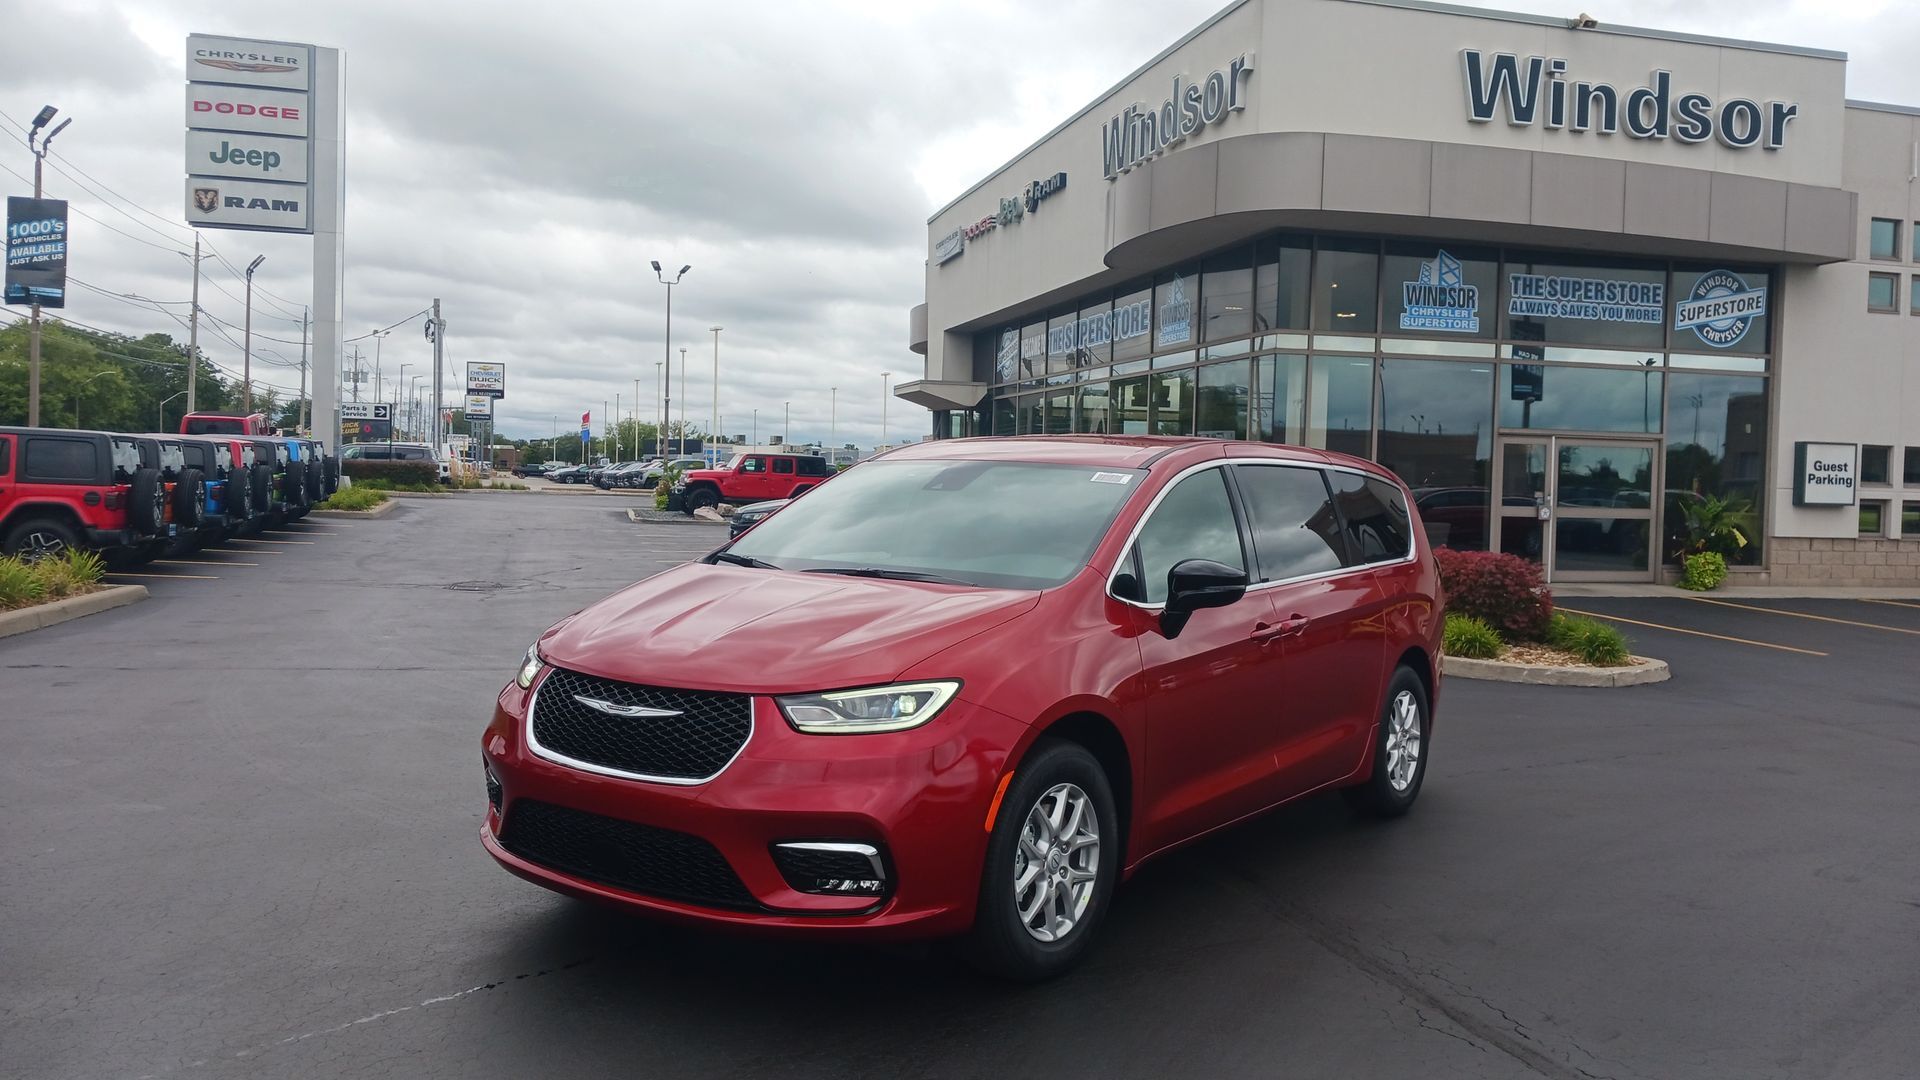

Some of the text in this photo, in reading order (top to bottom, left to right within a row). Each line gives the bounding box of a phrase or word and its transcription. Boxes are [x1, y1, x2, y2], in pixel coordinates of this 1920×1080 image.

[195, 49, 299, 65] CHRYSLER
[1459, 48, 1800, 150] Windsor
[193, 100, 300, 120] DODGE
[1102, 53, 1255, 181] Windsor
[209, 141, 281, 171] Jeep
[1034, 172, 1067, 201] RAM
[224, 195, 299, 213] RAM
[10, 219, 64, 237] 1000's
[23, 233, 62, 243] VEHICLES
[963, 215, 997, 241] DODGE
[9, 256, 30, 266] JUST
[32, 254, 49, 263] ASK
[10, 243, 64, 258] AVAILABLE
[1511, 275, 1662, 305] THE SUPERSTORE
[1696, 275, 1739, 296] WINDSOR
[1406, 285, 1476, 309] WINDSOR
[1411, 307, 1469, 318] CHRYSLER
[1510, 300, 1662, 323] ALWAYS SAVES YOU MORE!
[1679, 296, 1762, 322] SUPERSTORE
[1403, 317, 1477, 329] SUPERSTORE
[1703, 320, 1745, 343] CHRYSLER
[1049, 327, 1063, 354] THE
[1813, 460, 1848, 472] Guest
[1808, 473, 1853, 488] Parking
